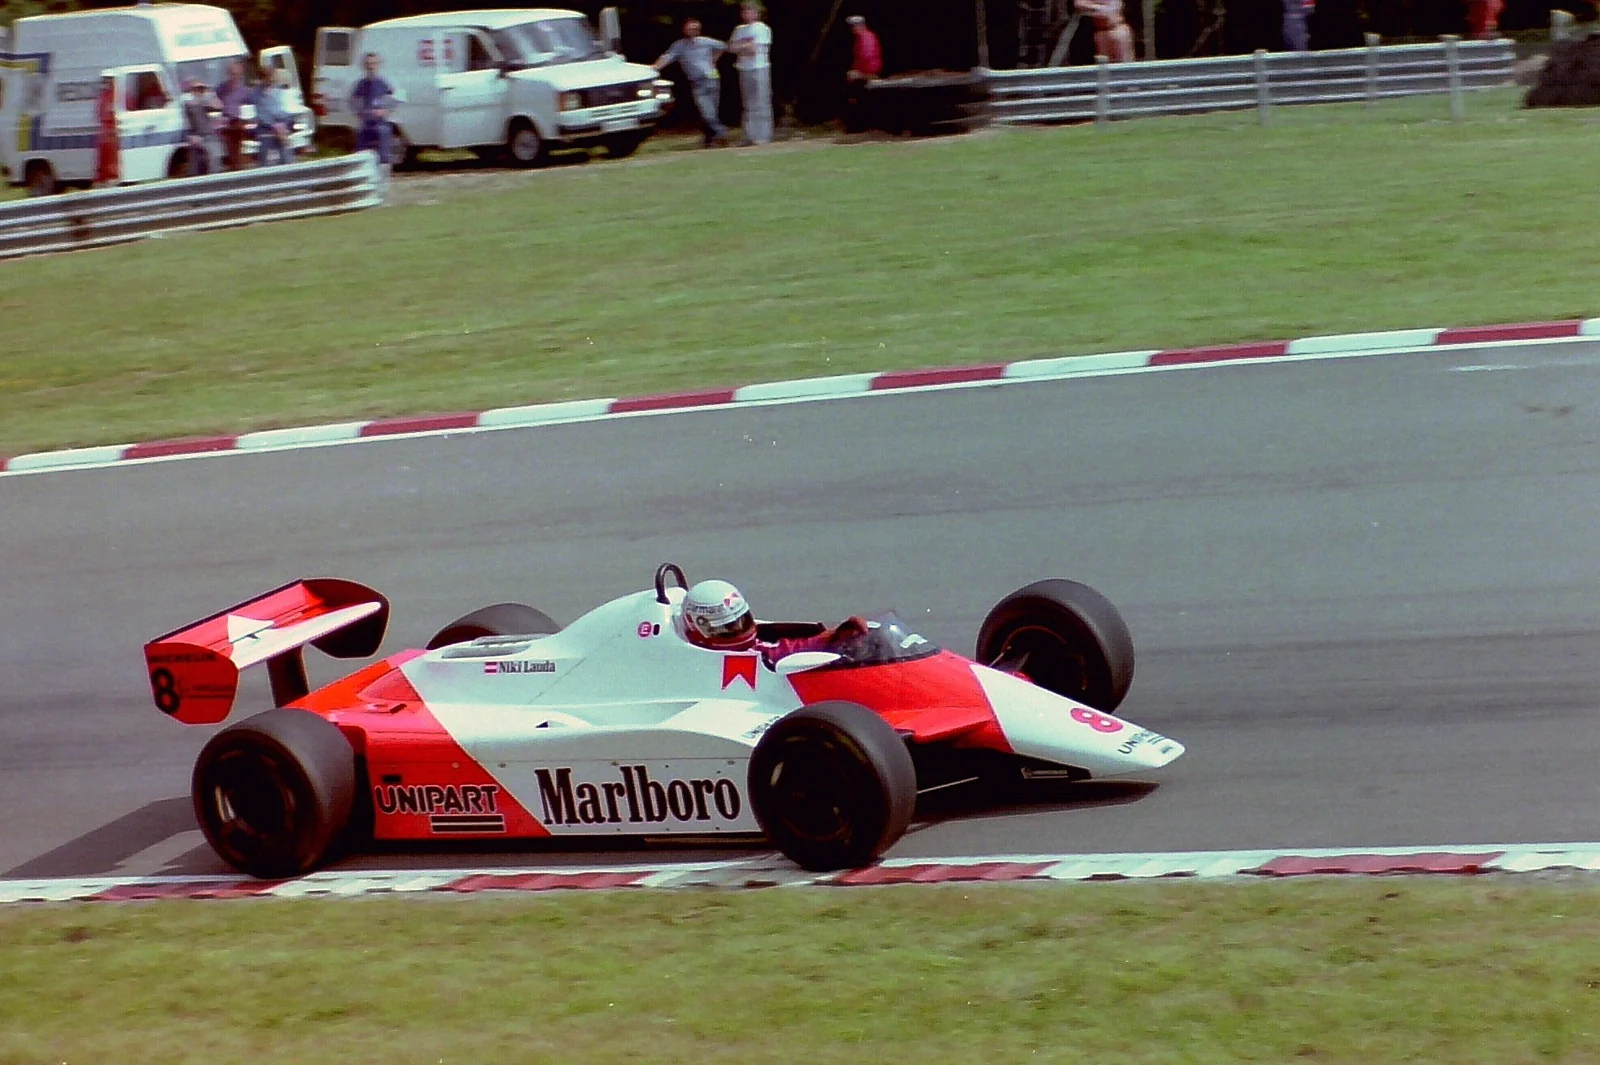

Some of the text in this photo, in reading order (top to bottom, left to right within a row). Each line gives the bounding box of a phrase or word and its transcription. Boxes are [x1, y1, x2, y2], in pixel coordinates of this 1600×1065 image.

[639, 623, 651, 636] E
[498, 660, 555, 673] Niki Lauda
[152, 668, 180, 714] 8
[1070, 708, 1124, 732] 8
[375, 785, 499, 814] UNIPART
[535, 766, 741, 823] Marlboro
